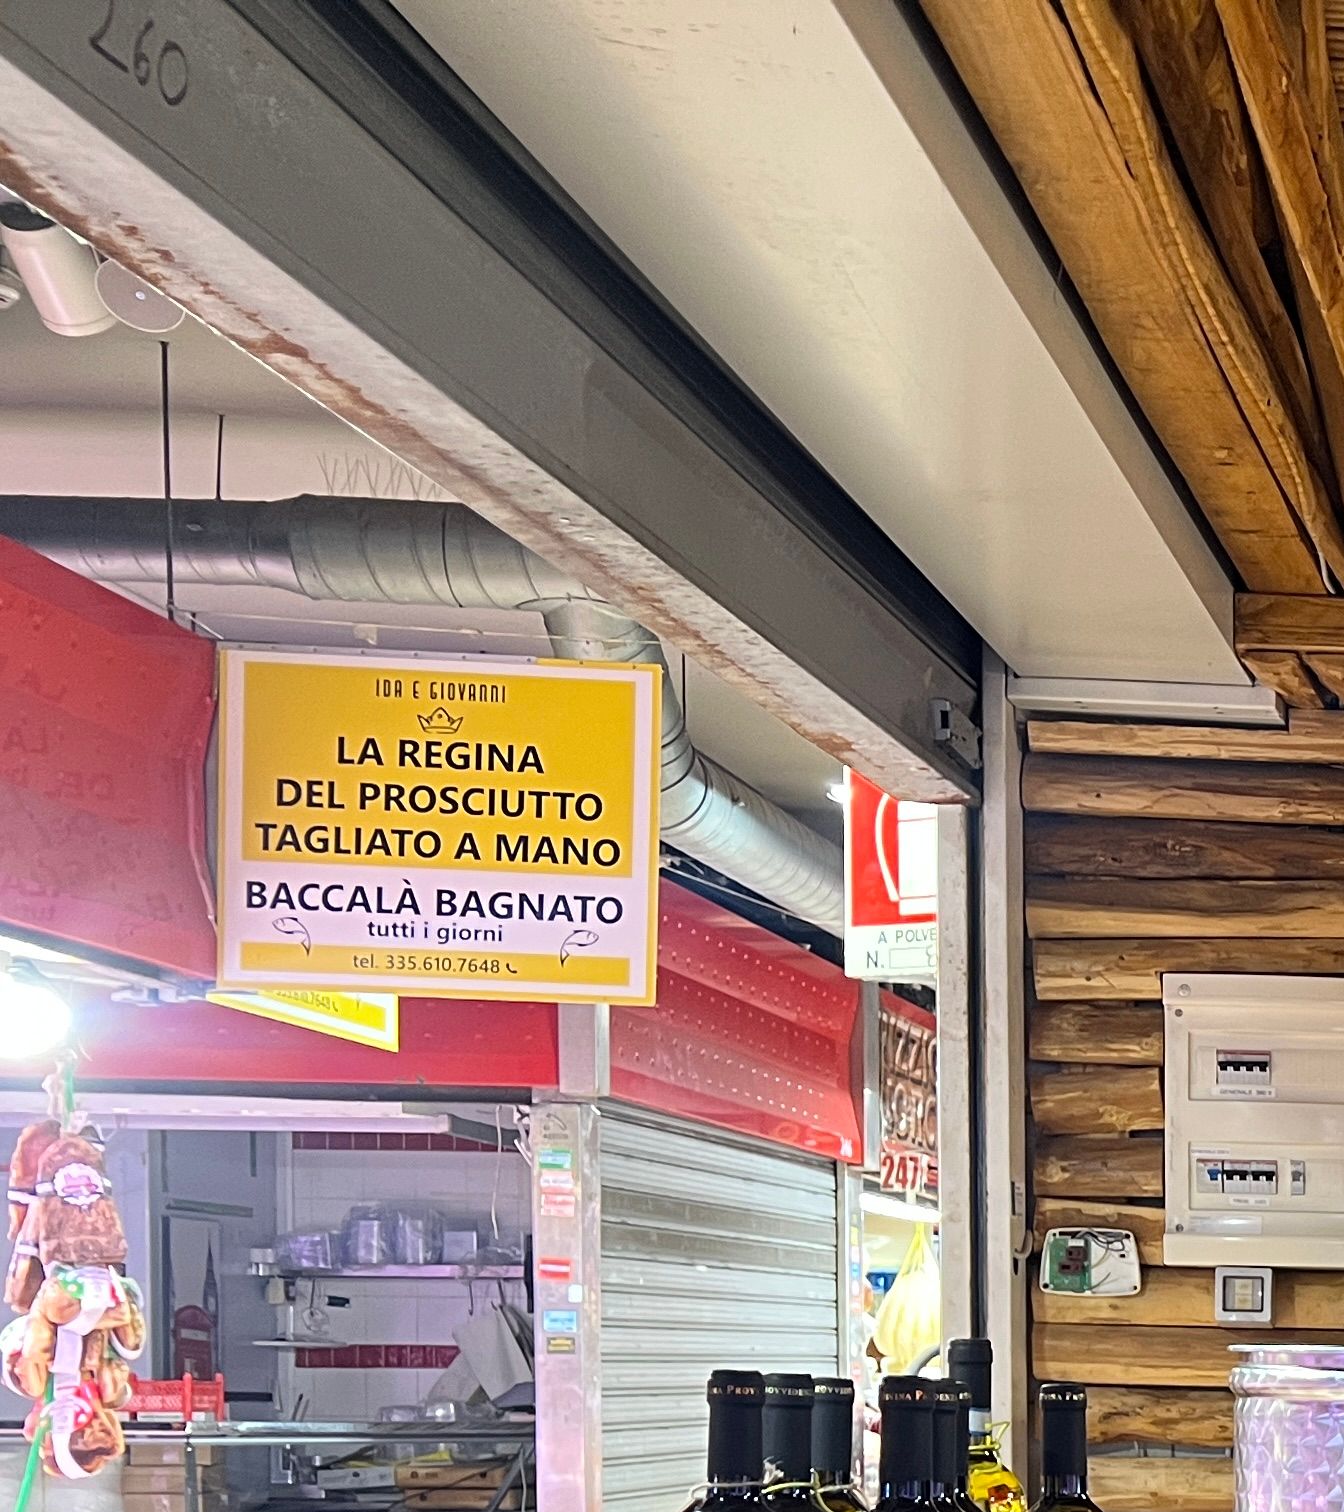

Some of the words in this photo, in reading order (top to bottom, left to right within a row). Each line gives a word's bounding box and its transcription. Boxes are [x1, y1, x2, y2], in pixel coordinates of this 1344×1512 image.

[376, 679, 402, 699] IDA
[412, 681, 420, 699] E
[429, 681, 507, 704] GIOVANNI
[337, 737, 384, 766] LA
[399, 740, 544, 773] REGINA
[276, 779, 344, 809] DEL
[359, 784, 602, 821] PROSCIUTTO
[255, 823, 441, 859] TAGLIATO
[454, 832, 480, 860] A
[495, 835, 620, 867] MANO
[246, 877, 420, 916] BACCALÀ
[436, 889, 623, 924] BAGNATO
[368, 922, 415, 939] tutti
[437, 924, 502, 944] giorni
[353, 954, 378, 970] tel.
[386, 956, 500, 974] 335.610.7648
[867, 951, 884, 969] N.
[882, 1153, 920, 1190] 247
